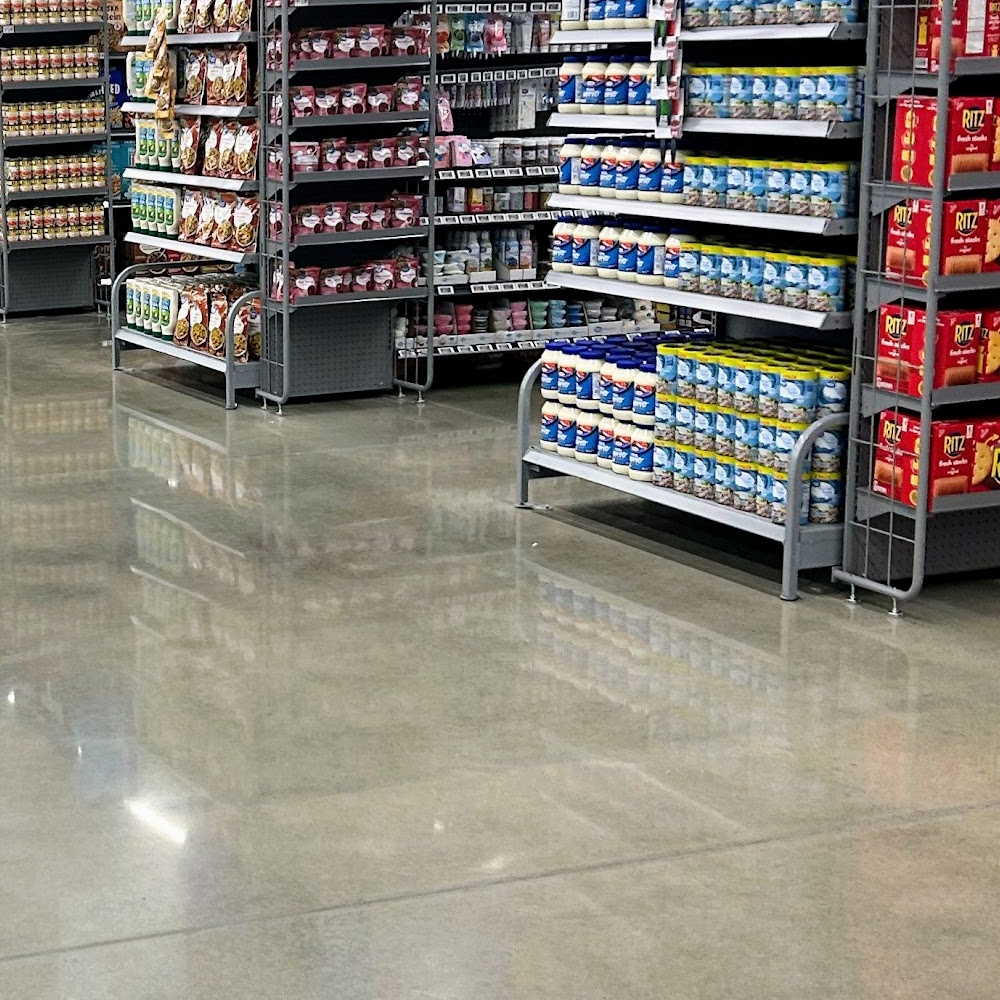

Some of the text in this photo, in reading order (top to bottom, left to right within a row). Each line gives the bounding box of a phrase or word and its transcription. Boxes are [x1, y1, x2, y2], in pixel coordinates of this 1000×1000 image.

[962, 109, 985, 129] RITZ
[894, 205, 978, 231] RITZ RITZ
[885, 315, 907, 336] RITZ
[955, 325, 975, 342] RITZ
[944, 436, 965, 453] RITZ
